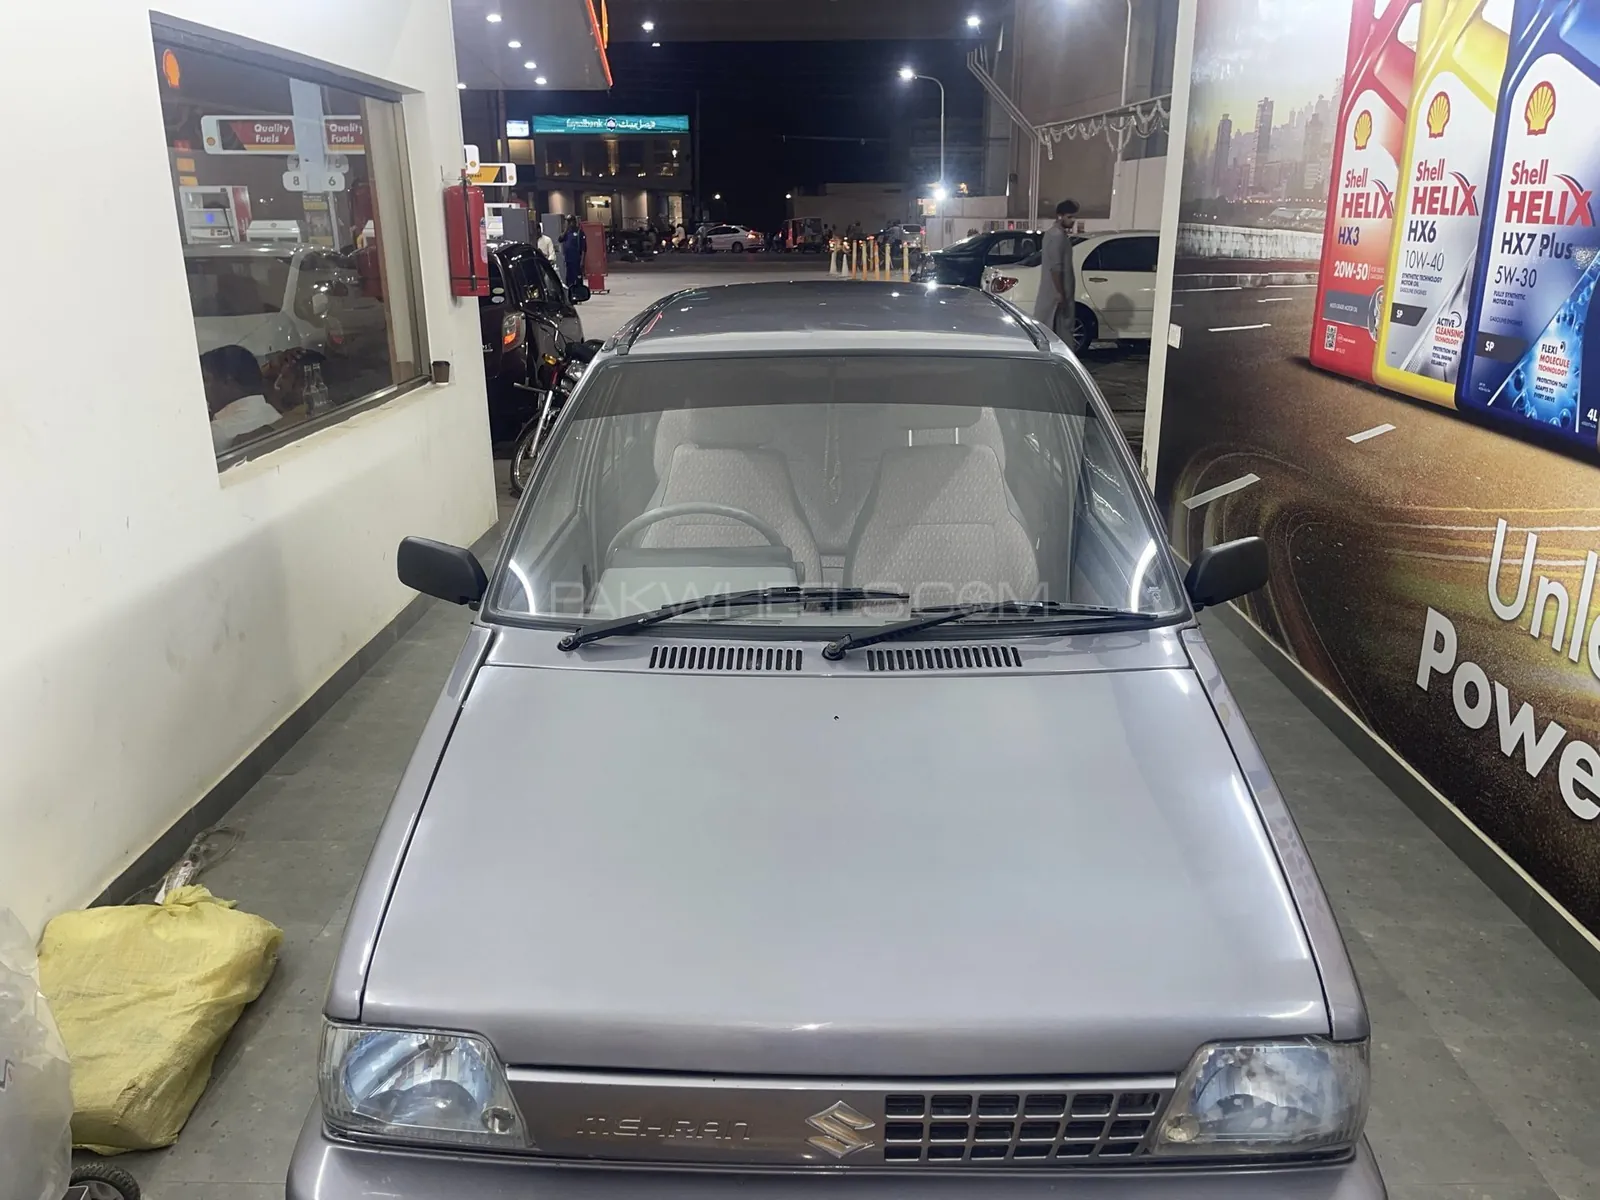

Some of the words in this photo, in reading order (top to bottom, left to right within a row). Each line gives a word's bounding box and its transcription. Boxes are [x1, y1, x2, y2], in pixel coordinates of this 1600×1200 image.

[254, 123, 290, 136] Quality
[255, 134, 280, 144] Fuels
[331, 134, 355, 144] Fuels
[1345, 167, 1369, 189] Shell
[1416, 158, 1446, 182] Shell
[1510, 158, 1549, 186] Shell
[292, 175, 301, 187] 8
[328, 175, 337, 187] 6
[1341, 179, 1394, 219] HELIX
[1411, 171, 1479, 217] HELIX
[1505, 173, 1596, 227] HELIX
[1337, 226, 1360, 246] HX3
[1407, 220, 1437, 243] HX6
[1500, 231, 1538, 256] HX7
[1538, 232, 1574, 260] Plus
[1333, 260, 1369, 281] 20W-50
[1405, 249, 1445, 272] 10W-40
[1494, 265, 1537, 289] 5W-30
[1396, 309, 1404, 319] SP
[1437, 316, 1455, 328] ACTIVE
[1435, 326, 1464, 339] CLEANSING
[1484, 340, 1495, 352] SP
[1541, 343, 1558, 355] FLEXI
[1538, 364, 1568, 377] TECHNOLOGY
[1540, 354, 1570, 368] MOLECULE
[1587, 408, 1598, 422] 4L
[1416, 606, 1600, 820] Powe
[576, 1116, 752, 1142] MEHRAN
